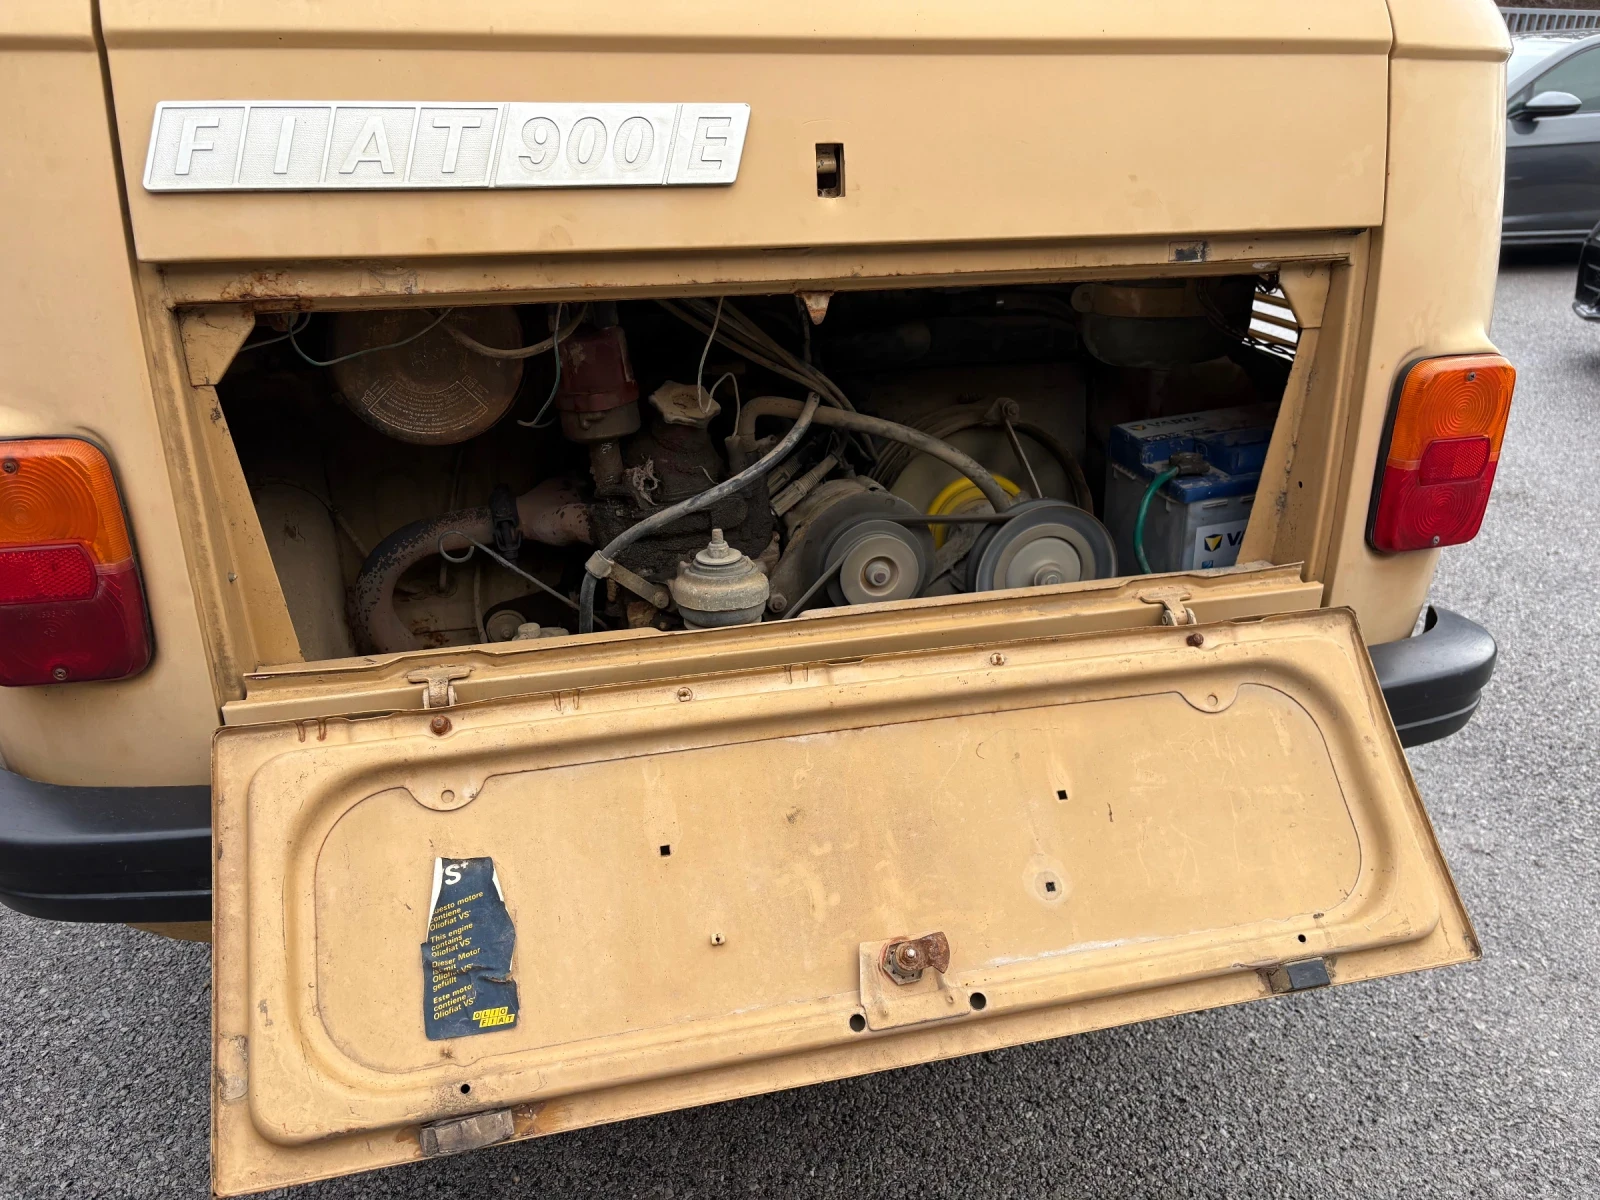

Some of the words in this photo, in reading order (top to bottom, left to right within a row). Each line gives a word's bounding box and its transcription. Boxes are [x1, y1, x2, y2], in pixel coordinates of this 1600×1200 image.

[174, 116, 481, 176] FIAT
[518, 116, 655, 173] 900
[686, 117, 732, 172] E
[457, 891, 484, 905] motore
[430, 916, 457, 931] Oliofiat
[430, 933, 446, 943] This
[448, 922, 473, 937] engine
[431, 935, 462, 951] contains
[431, 944, 458, 957] Oliofiat
[432, 957, 456, 968] Dieser
[458, 947, 481, 961] Motor
[432, 976, 457, 993] gefüllt
[433, 993, 450, 1004] Este
[433, 994, 467, 1012] contiene
[433, 1004, 462, 1020] Oliofiat
[474, 1007, 507, 1019] OLIO
[481, 1015, 513, 1026] FIAT
